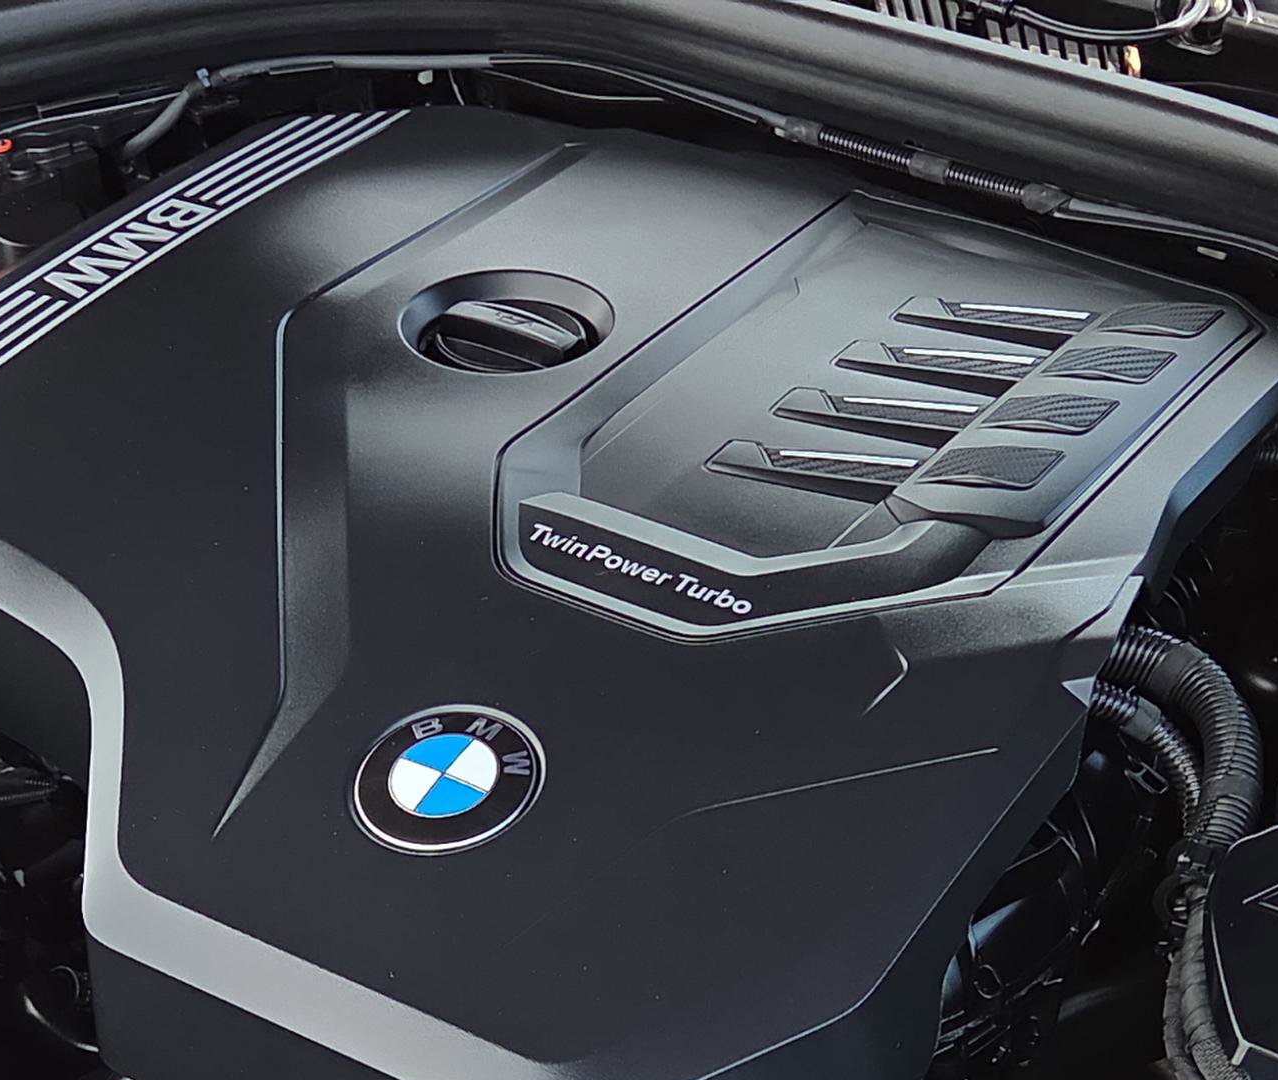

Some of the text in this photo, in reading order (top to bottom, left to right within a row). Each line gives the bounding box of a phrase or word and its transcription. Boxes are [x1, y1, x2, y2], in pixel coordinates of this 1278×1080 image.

[43, 197, 218, 299] BMW
[529, 523, 753, 615] TwinPower Turbo
[411, 717, 531, 776] BMW
